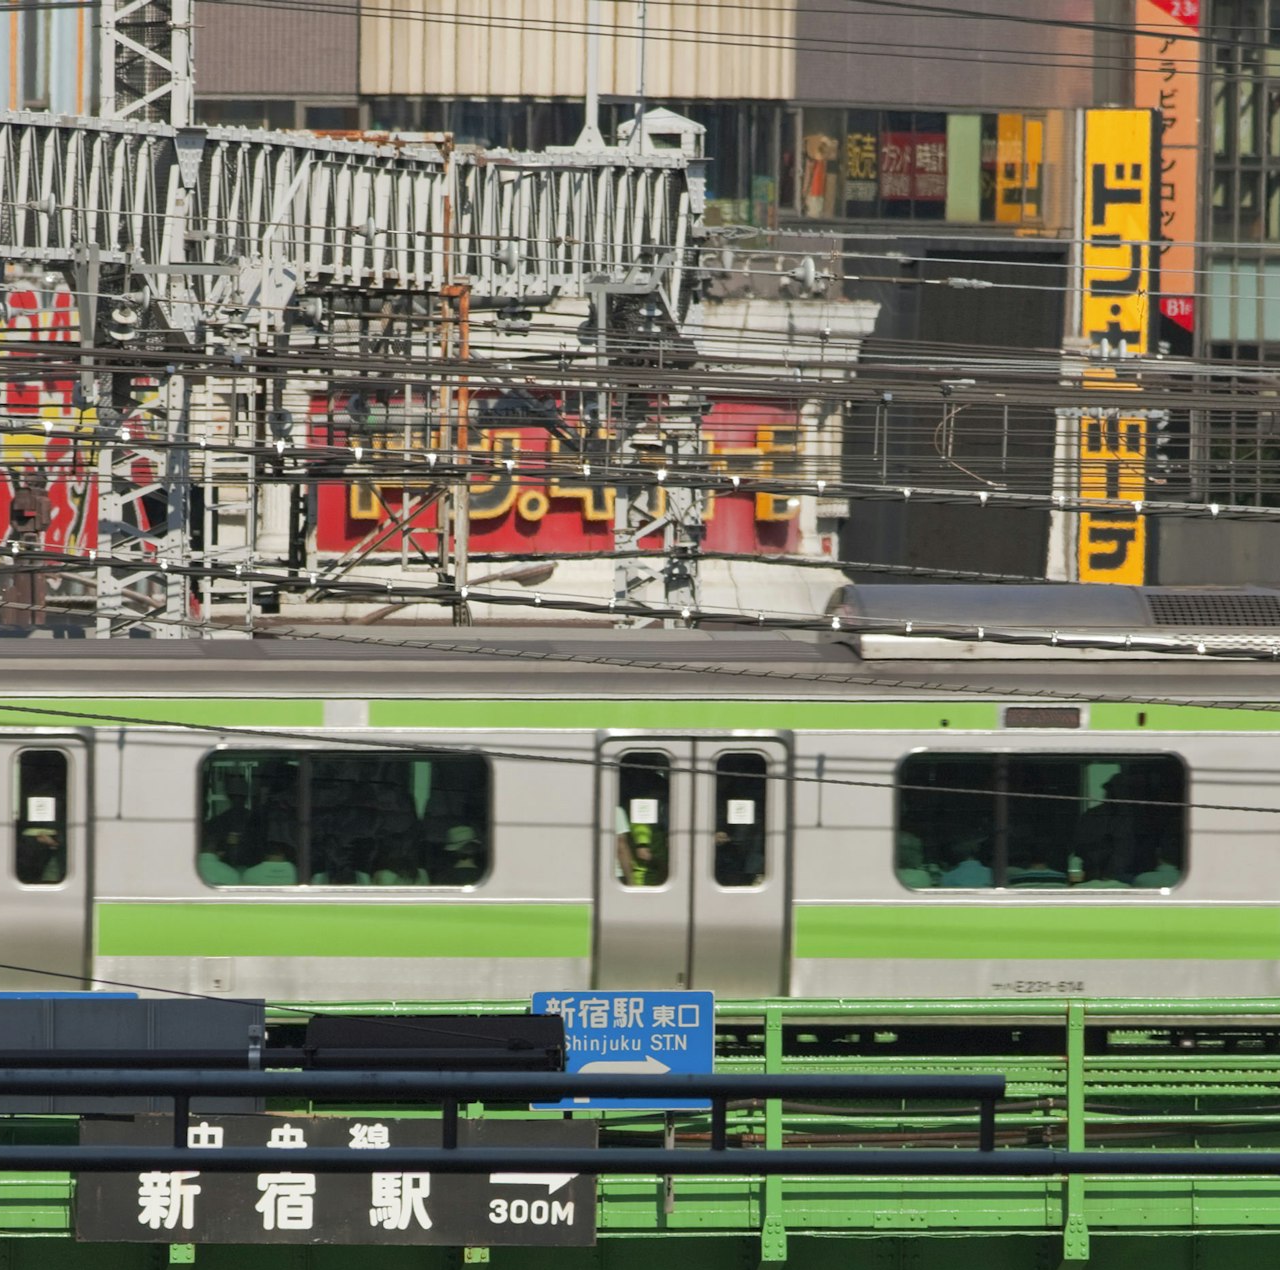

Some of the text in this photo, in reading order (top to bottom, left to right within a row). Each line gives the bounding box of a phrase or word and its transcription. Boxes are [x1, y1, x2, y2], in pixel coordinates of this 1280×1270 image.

[564, 1033, 642, 1055] Shinjuku
[137, 1171, 433, 1230] 新宿駅
[488, 1199, 576, 1227] 300M
